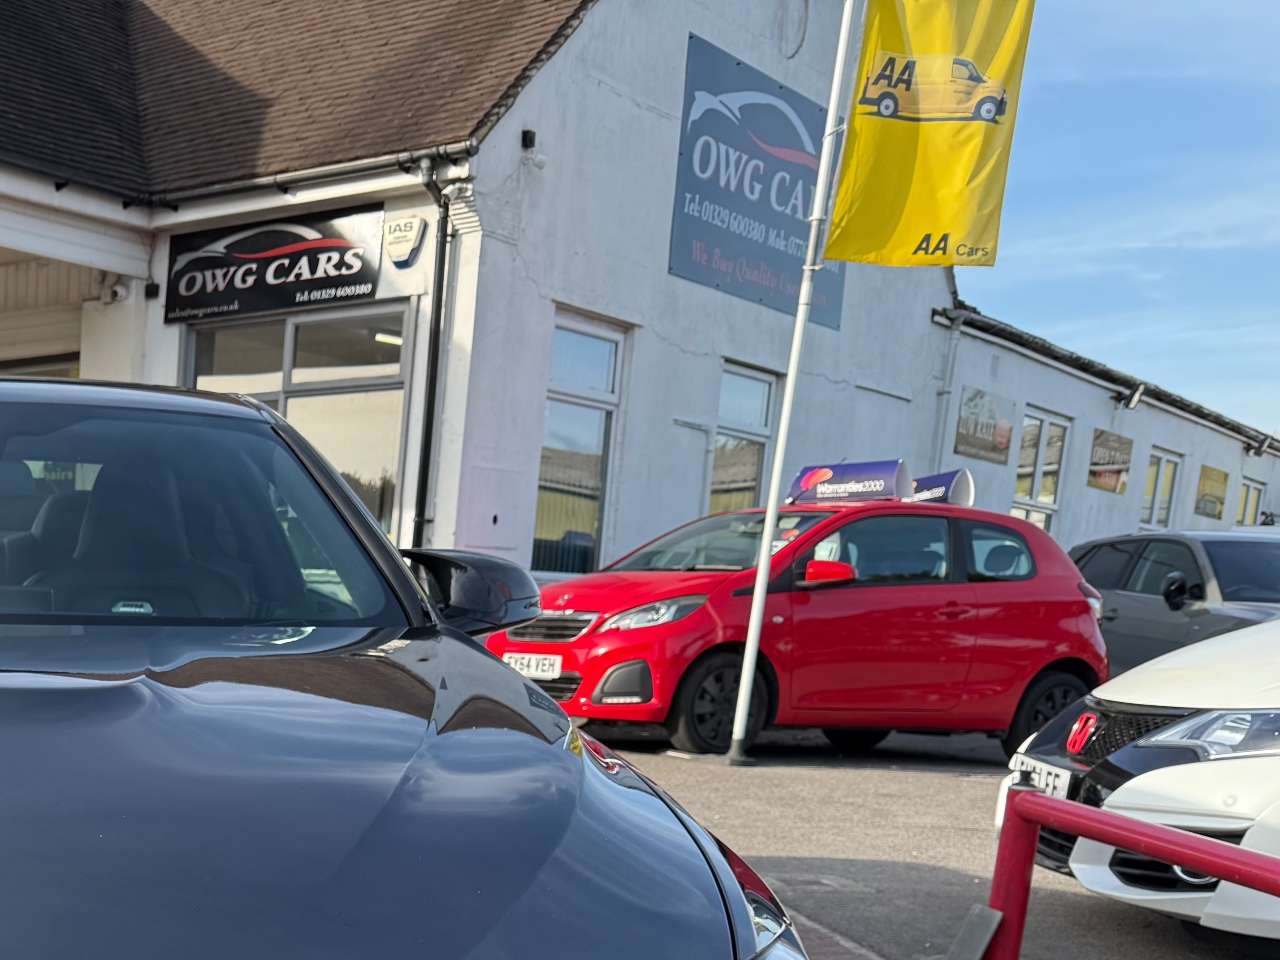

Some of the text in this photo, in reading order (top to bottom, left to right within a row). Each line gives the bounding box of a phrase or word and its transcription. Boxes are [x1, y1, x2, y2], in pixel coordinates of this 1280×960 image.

[872, 56, 916, 91] AA
[692, 135, 764, 200] OWG
[389, 221, 413, 234] IAS
[701, 200, 729, 228] 01329
[729, 212, 766, 243] 600380
[912, 233, 989, 257] AA Cars
[178, 248, 364, 296] OWG CARS
